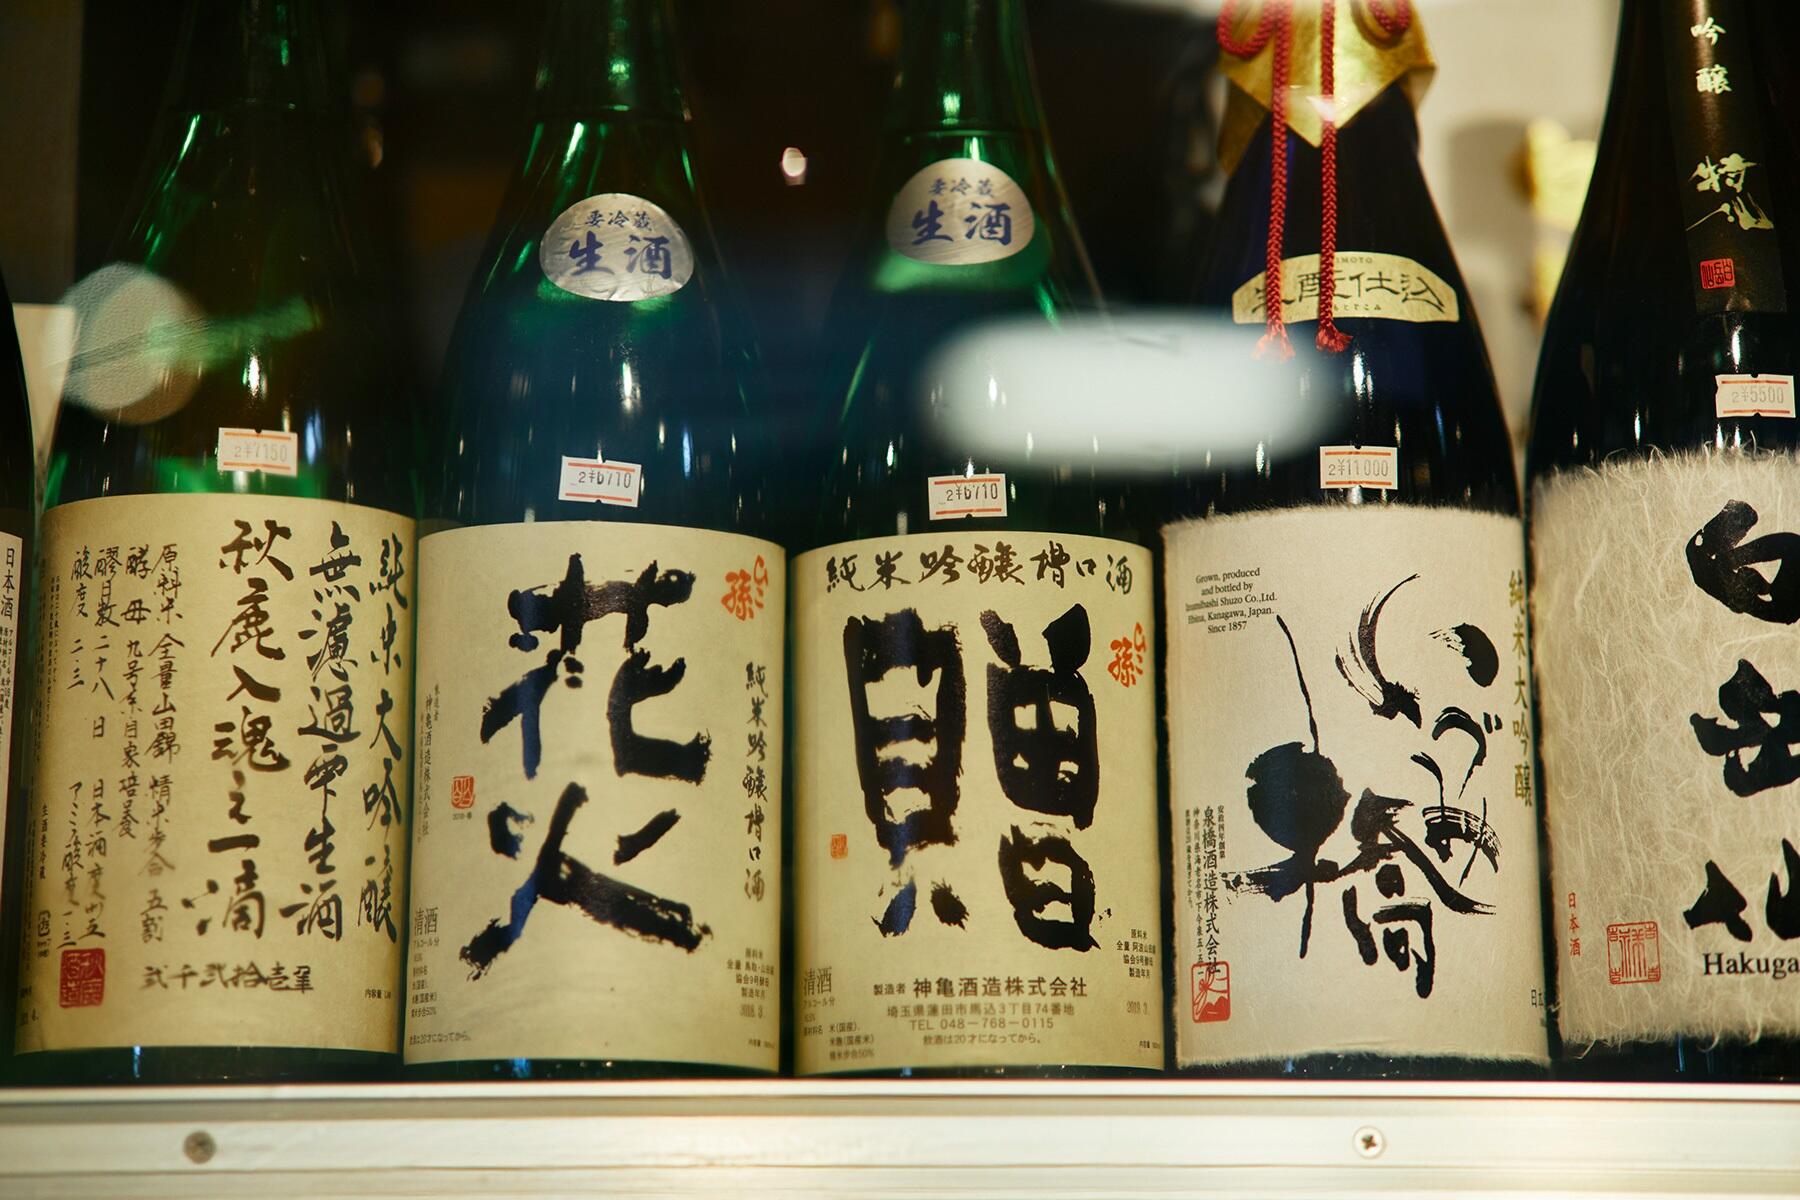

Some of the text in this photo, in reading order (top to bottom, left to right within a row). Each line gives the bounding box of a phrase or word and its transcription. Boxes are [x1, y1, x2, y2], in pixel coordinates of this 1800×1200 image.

[1690, 17, 1732, 94] 吟醸
[911, 200, 1012, 246] 生酒
[569, 230, 672, 280] 生酒
[1, 547, 15, 620] 日本酒
[1195, 567, 1260, 584] Grown, produced
[1201, 581, 1253, 596] and bottled by
[1220, 595, 1243, 607] Shuzo
[1207, 610, 1246, 621] Kanagawa,
[1248, 607, 1274, 618] Japan.
[1207, 620, 1247, 634] Since 1857
[1202, 805, 1221, 974] 泉橋酒造株式会社
[1567, 892, 1582, 957] 日本酒
[1703, 951, 1800, 980] Hakuga
[912, 976, 1088, 998] 神亀酒造株式会社
[909, 1020, 934, 1031] TEL
